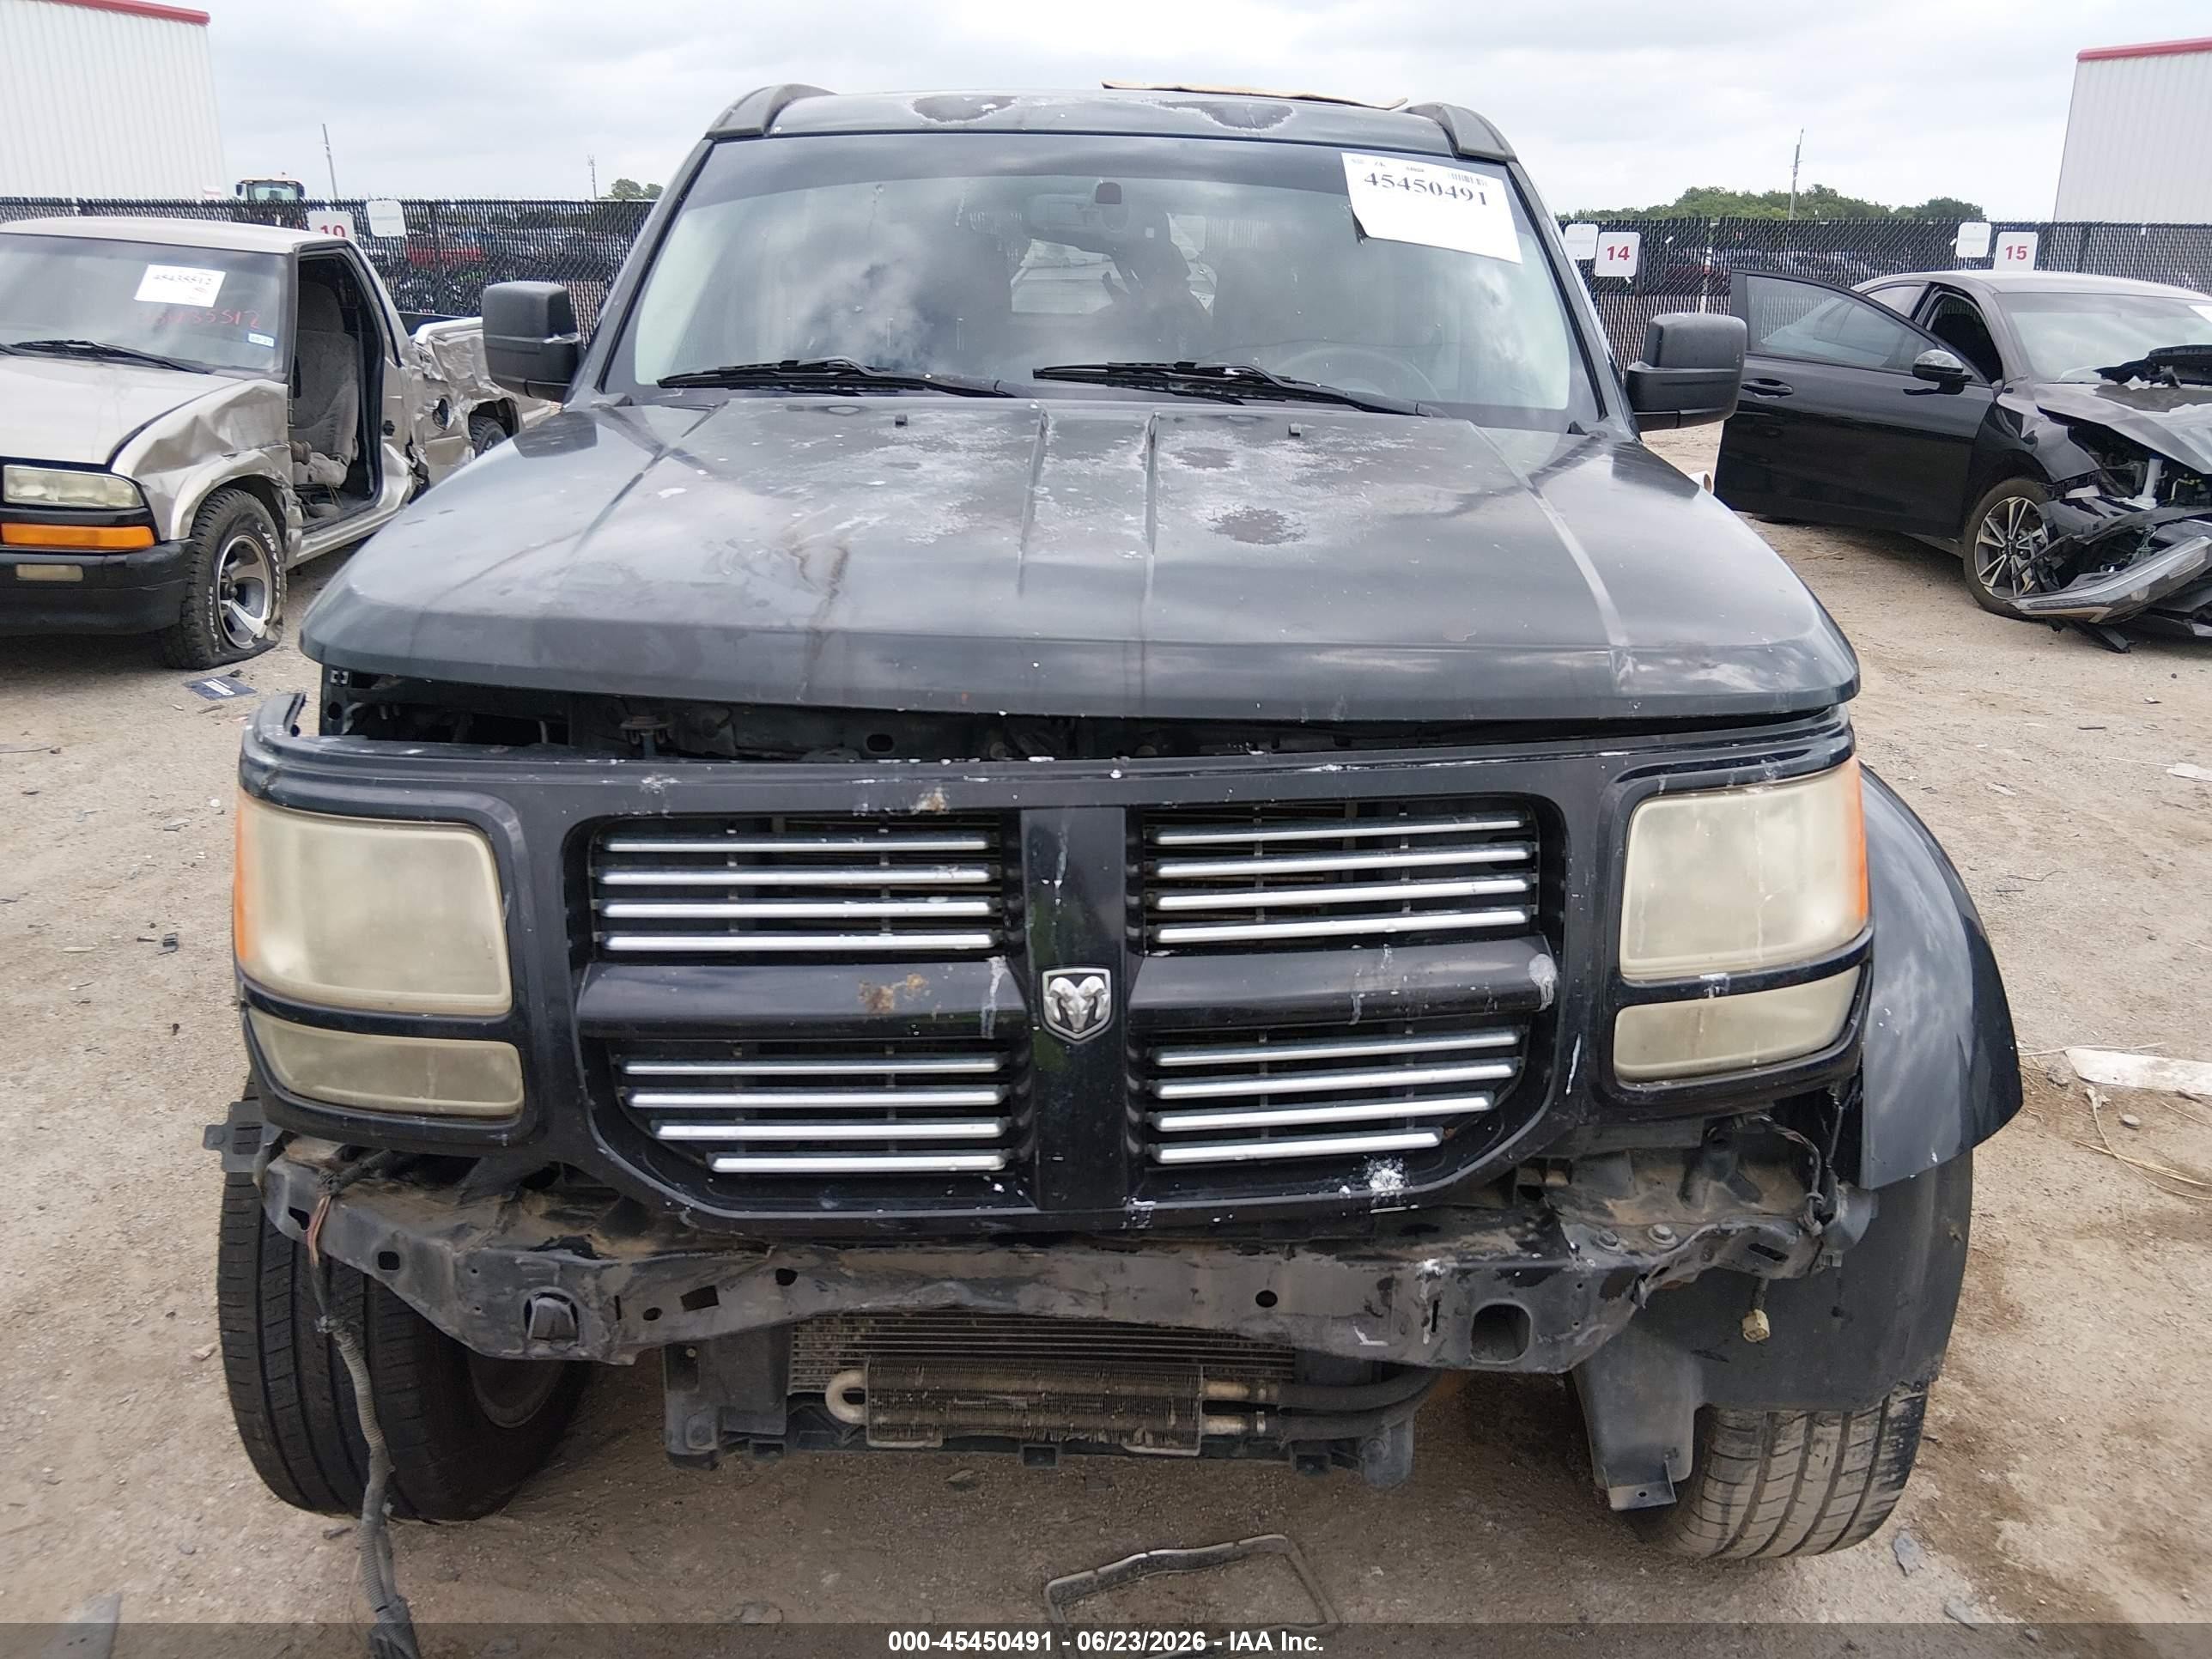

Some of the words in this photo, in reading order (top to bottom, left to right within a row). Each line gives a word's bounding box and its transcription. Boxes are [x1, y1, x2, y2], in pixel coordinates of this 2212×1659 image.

[1364, 172, 1487, 206] 45450491
[1607, 246, 1630, 261] 14
[2005, 246, 2028, 260] 15
